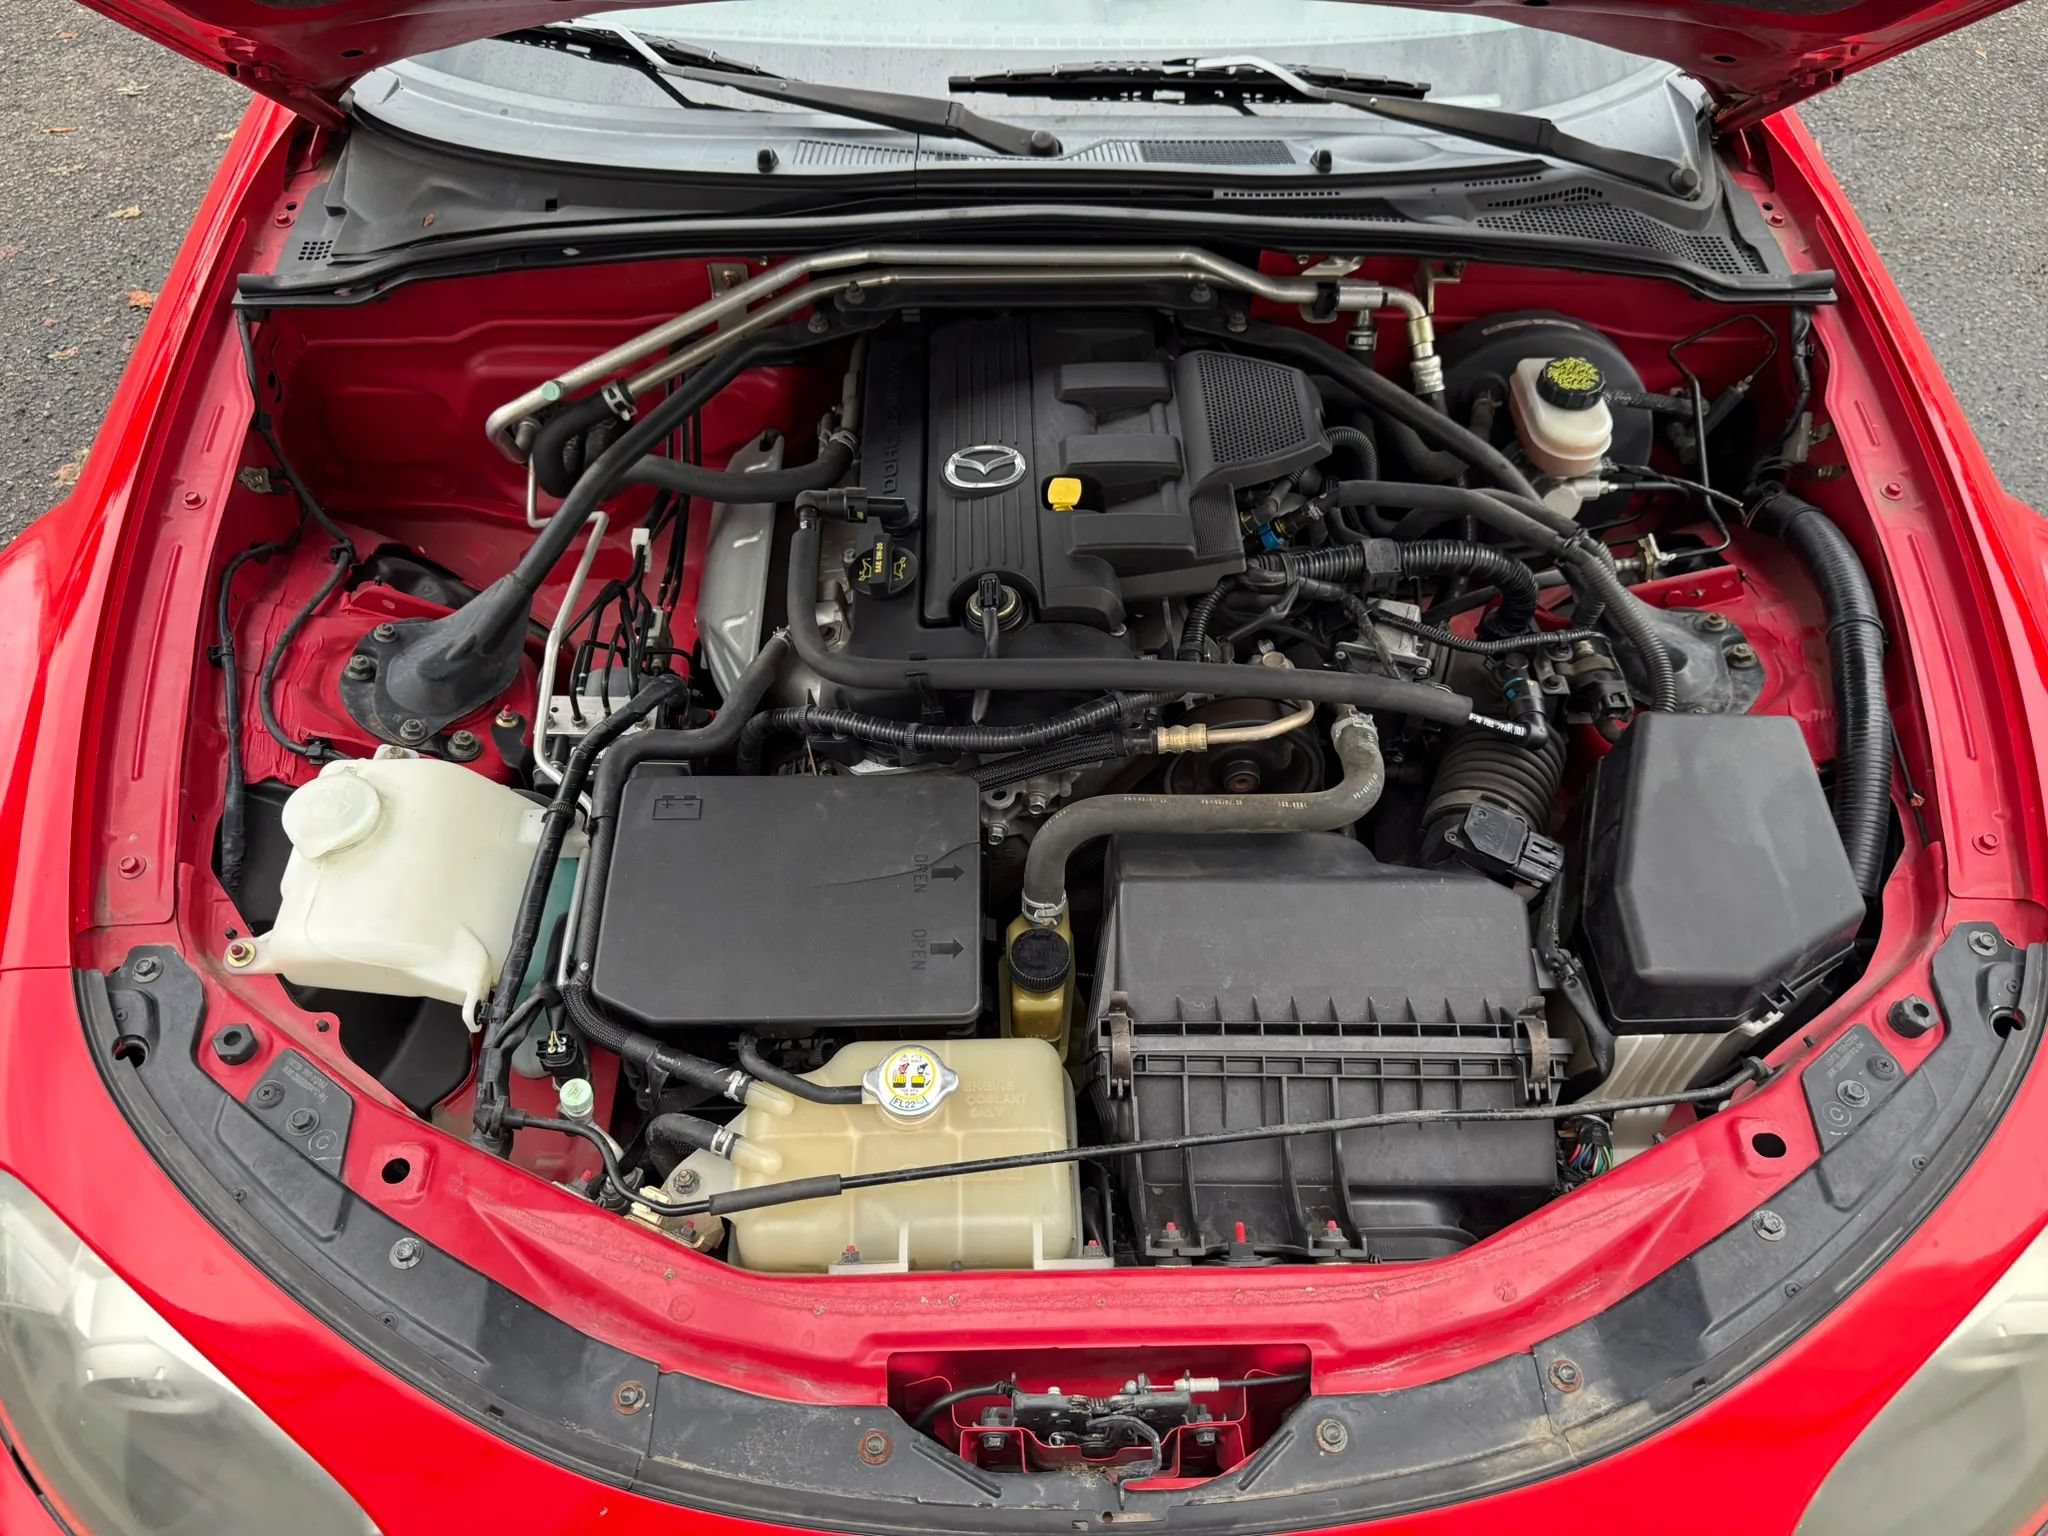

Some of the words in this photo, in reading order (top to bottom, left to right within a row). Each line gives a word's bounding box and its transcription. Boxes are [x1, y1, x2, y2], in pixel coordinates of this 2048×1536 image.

[913, 853, 929, 893] OPEN
[910, 928, 928, 971] OPEN
[962, 1080, 1016, 1093] ENGINE
